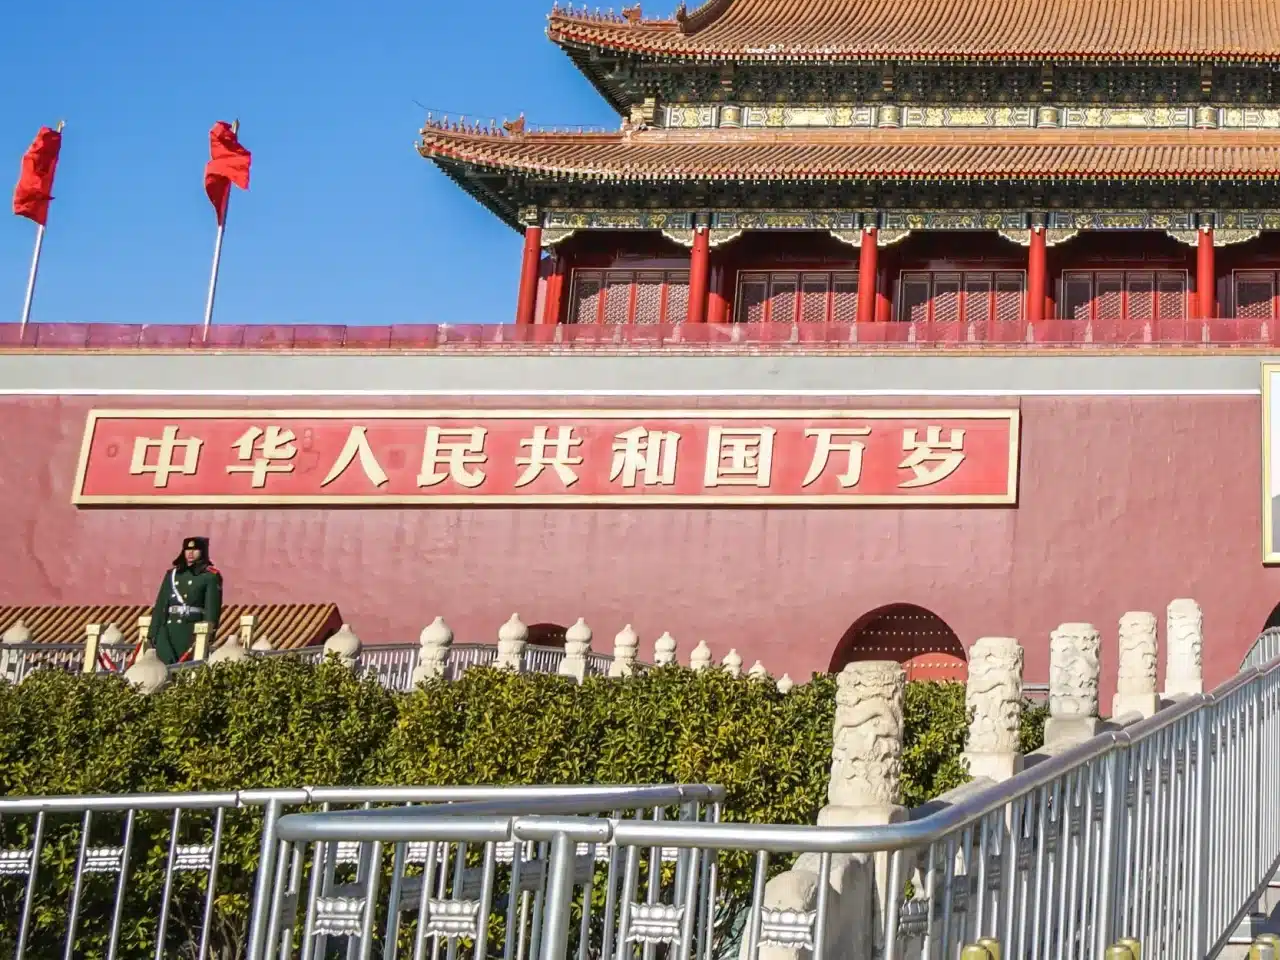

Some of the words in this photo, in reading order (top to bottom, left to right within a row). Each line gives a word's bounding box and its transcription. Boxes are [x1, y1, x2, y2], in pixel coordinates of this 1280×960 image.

[129, 425, 966, 488] 中华人民共和国万岁
